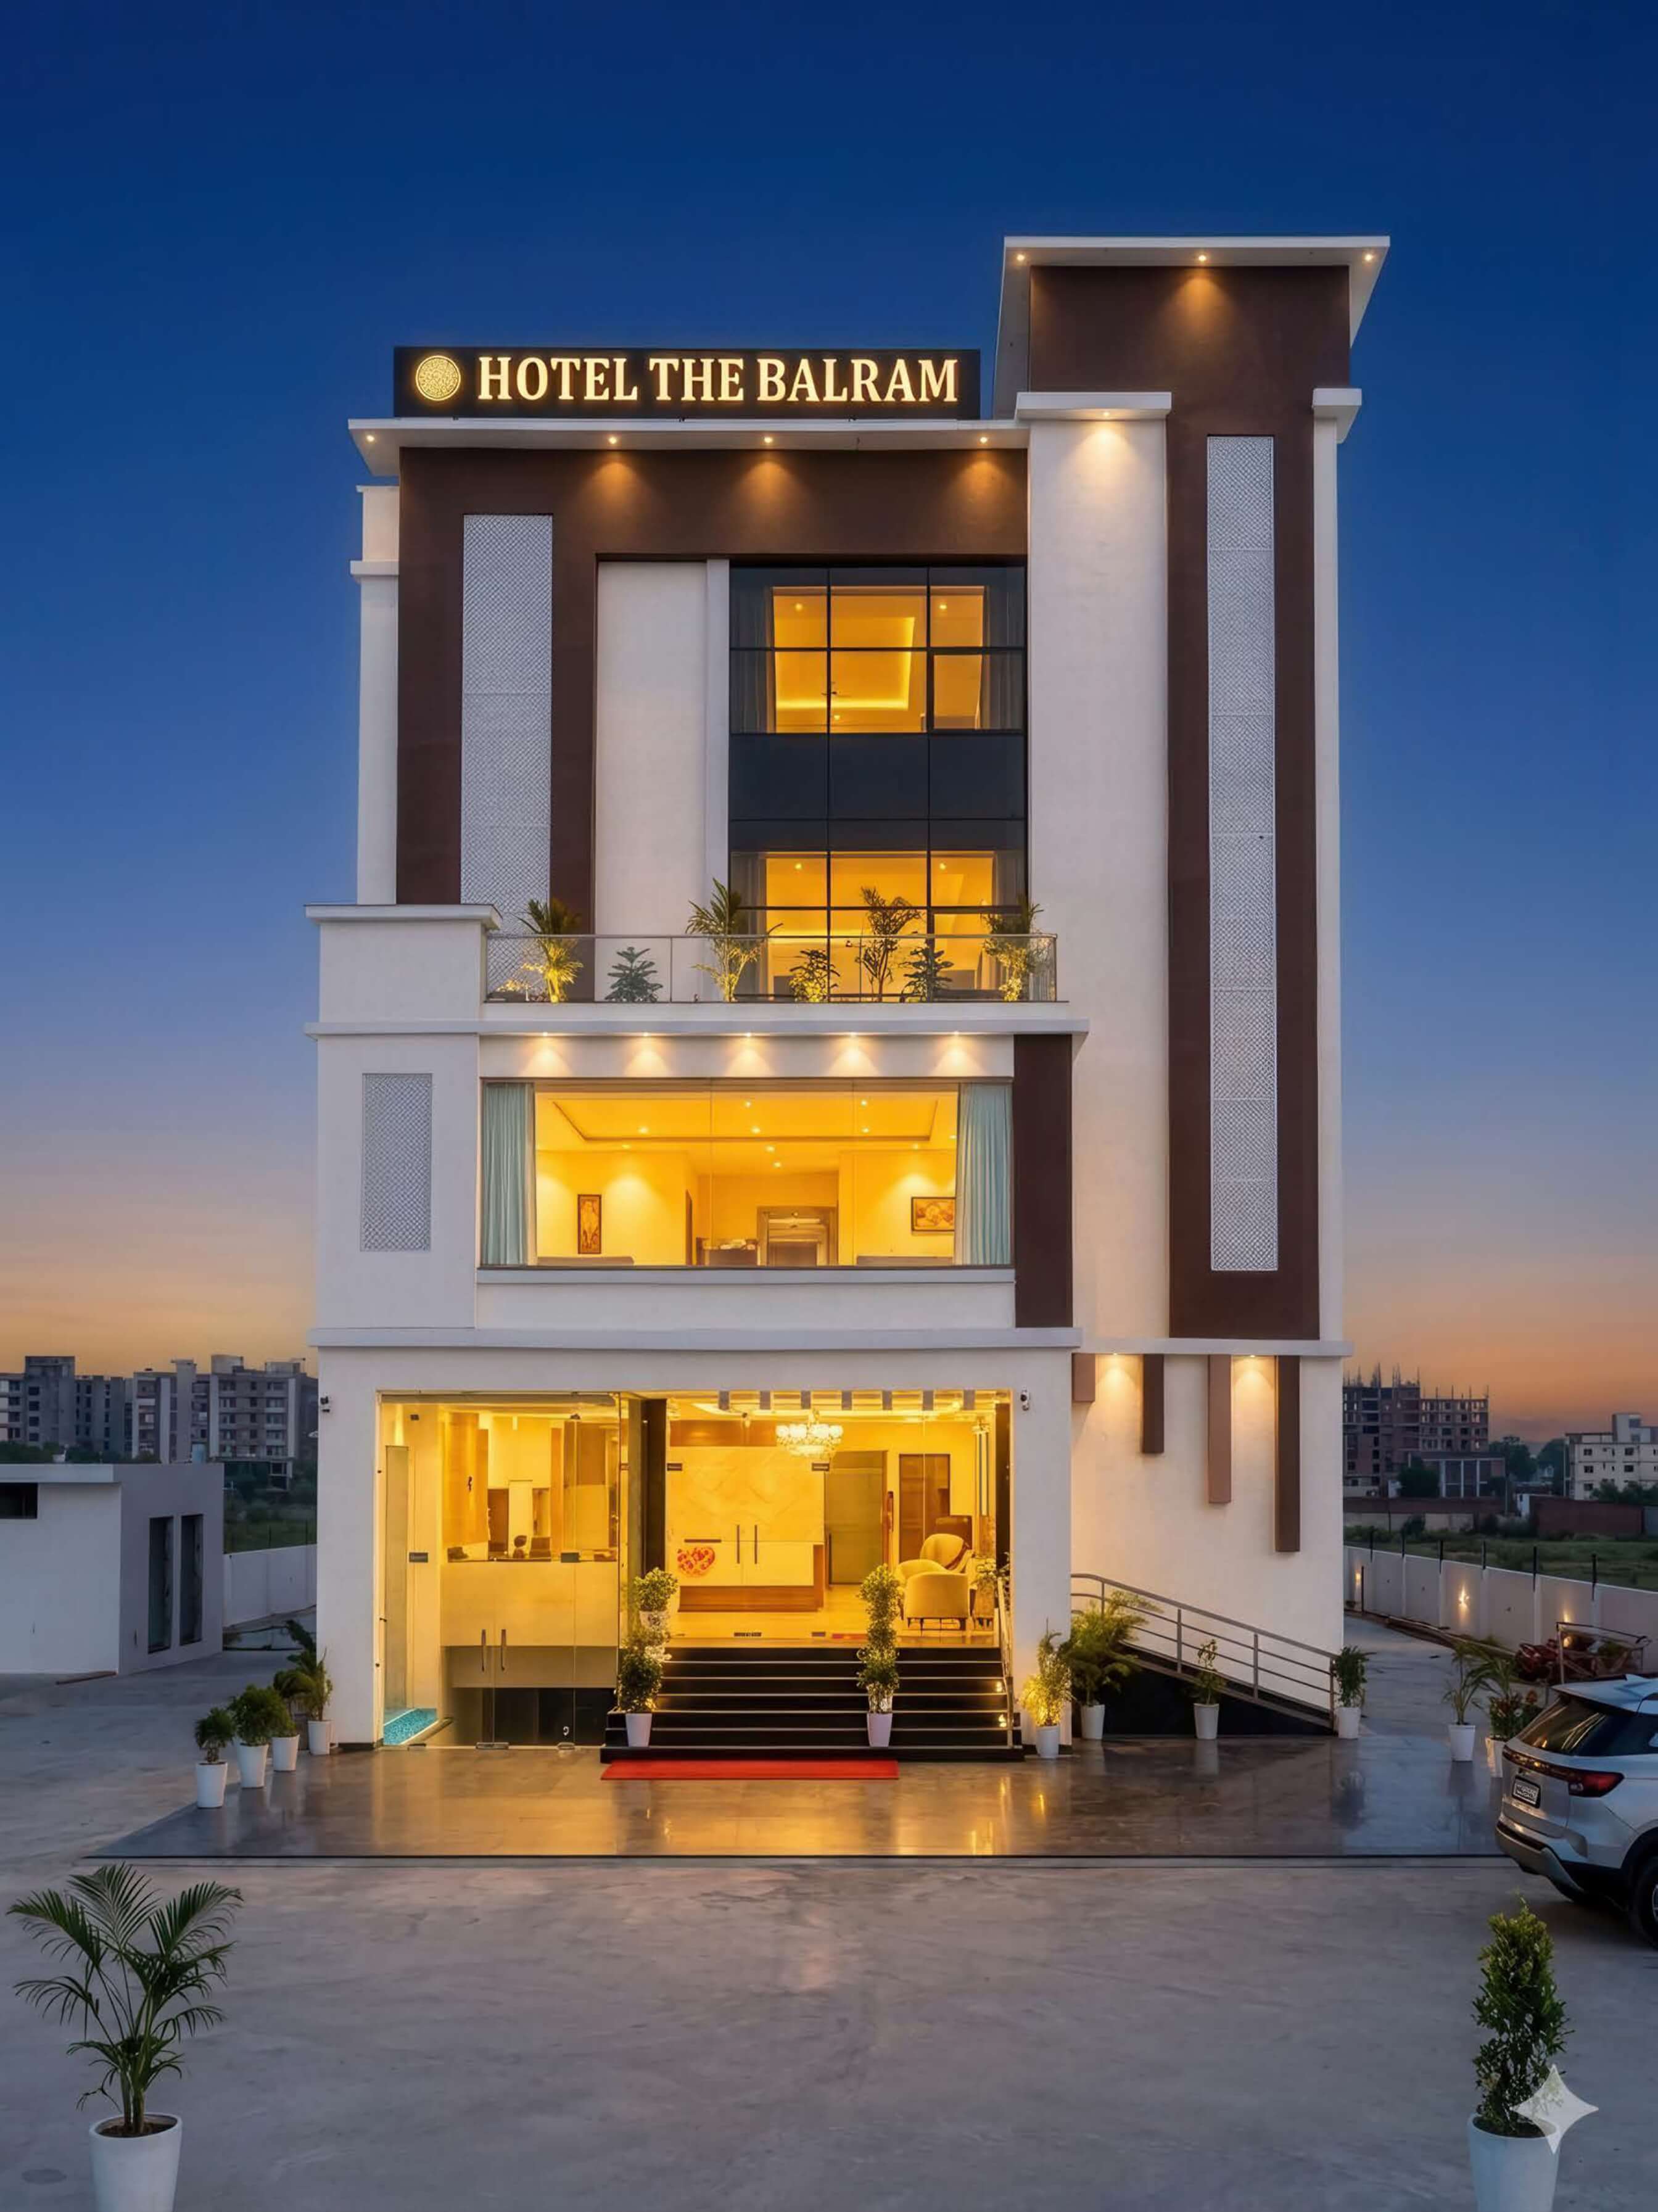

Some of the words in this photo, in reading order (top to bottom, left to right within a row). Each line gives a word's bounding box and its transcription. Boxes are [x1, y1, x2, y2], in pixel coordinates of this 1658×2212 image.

[479, 357, 637, 400] HOTEL
[650, 358, 743, 401] THE
[757, 358, 957, 402] BALRAM
